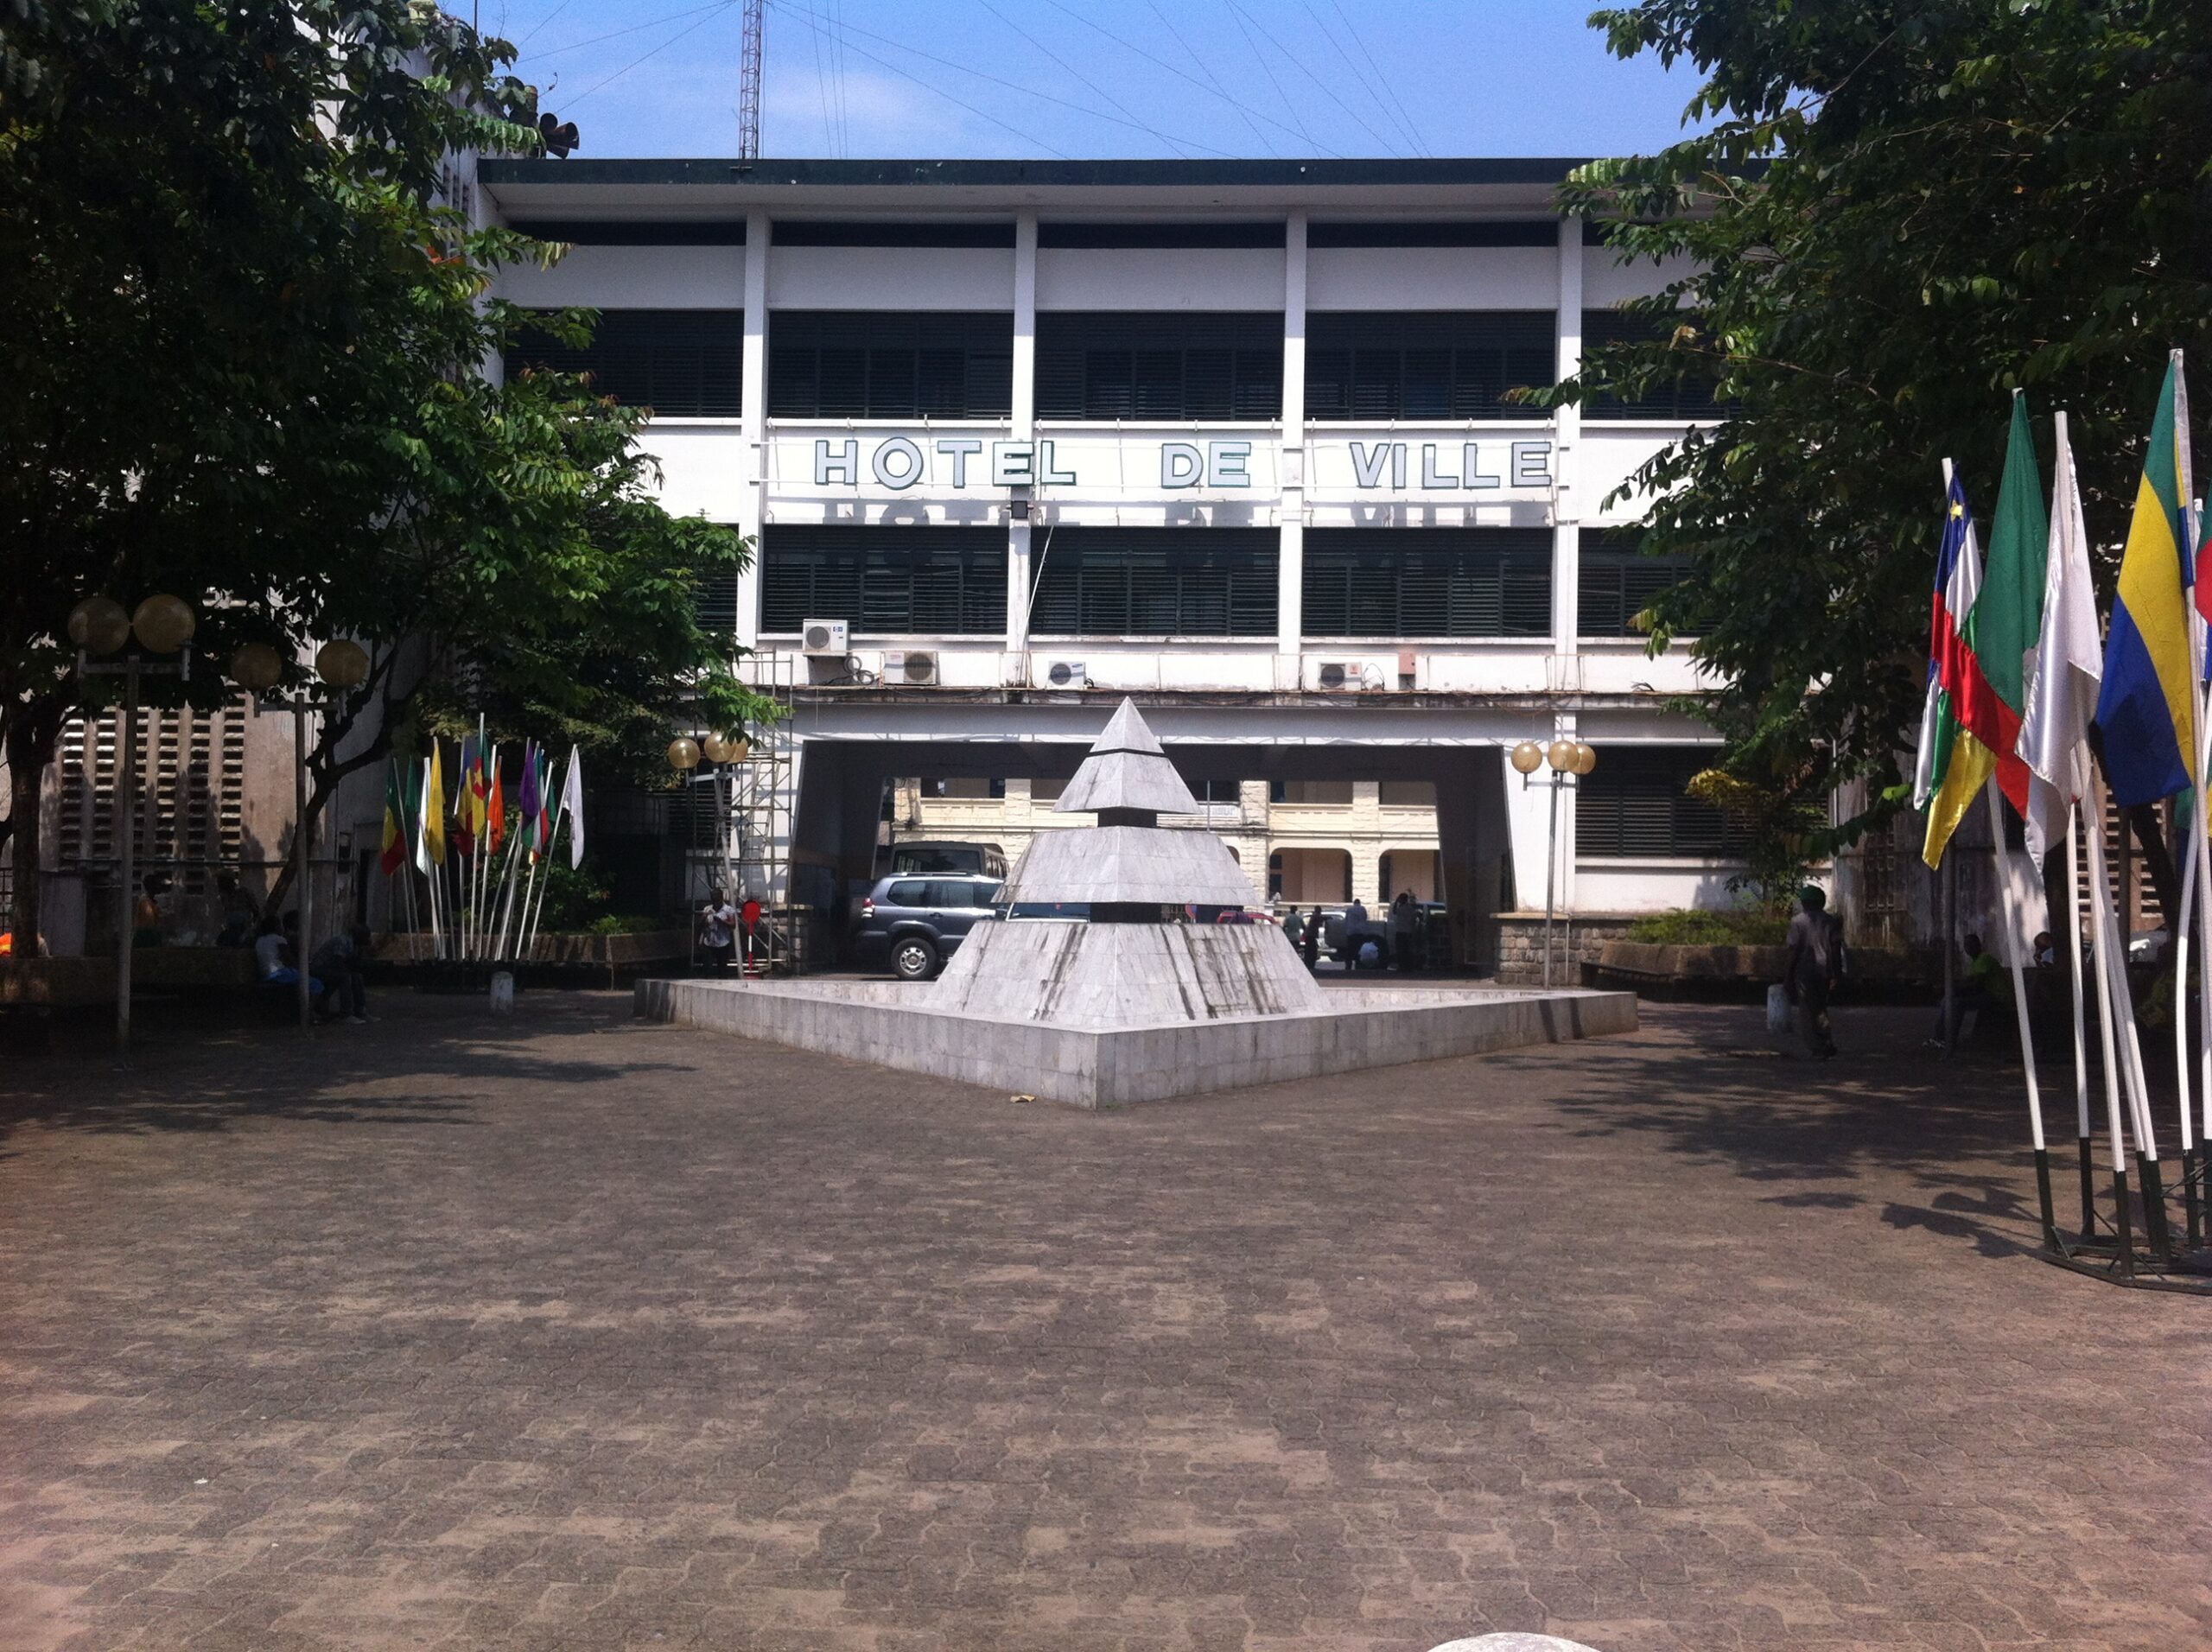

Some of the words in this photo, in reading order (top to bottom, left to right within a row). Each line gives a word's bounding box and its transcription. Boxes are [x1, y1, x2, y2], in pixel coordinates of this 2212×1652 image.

[815, 437, 1077, 490] HOTEL
[1161, 442, 1251, 489] DE
[1349, 442, 1552, 489] VILLE
